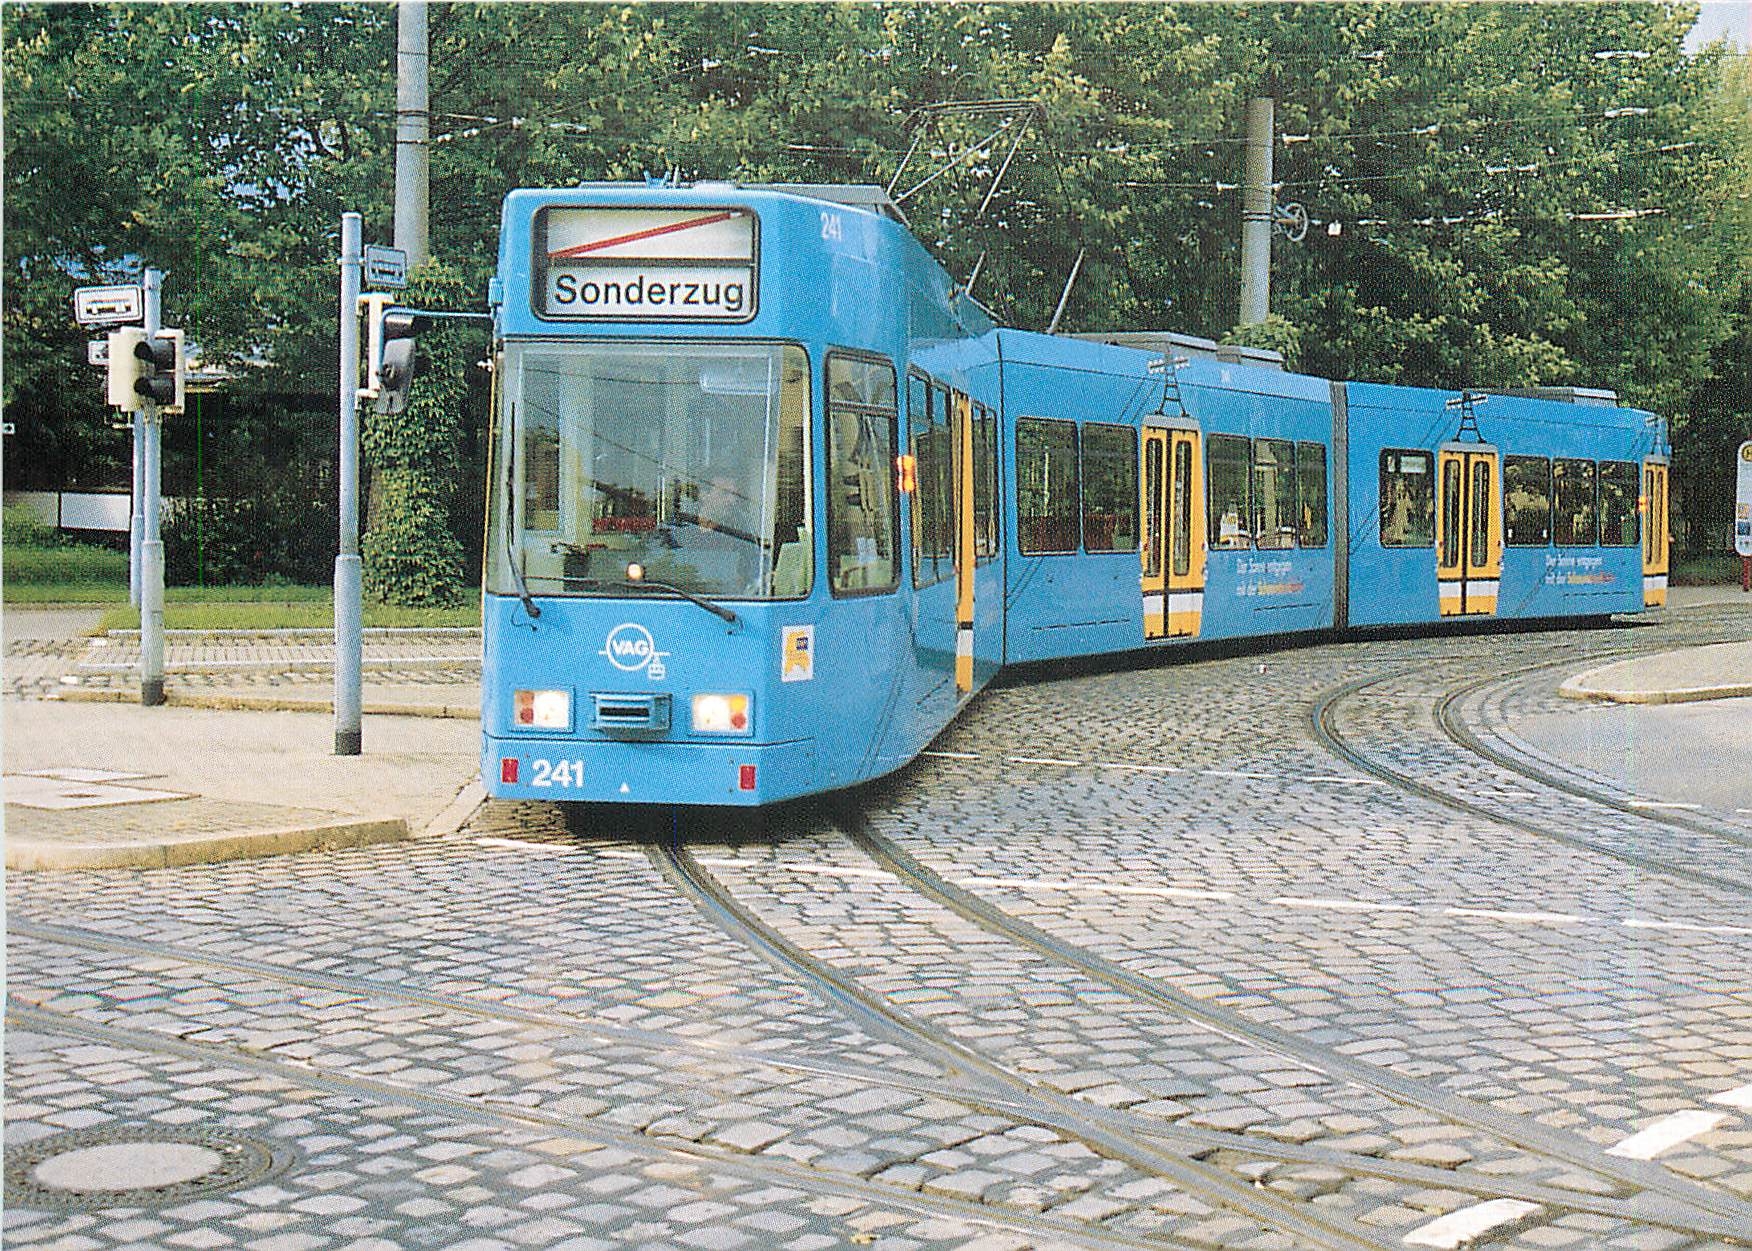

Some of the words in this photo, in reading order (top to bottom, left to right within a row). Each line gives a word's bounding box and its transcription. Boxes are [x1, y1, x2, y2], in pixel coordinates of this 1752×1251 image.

[820, 212, 843, 241] 241
[554, 274, 744, 311] Sonderzug
[611, 640, 649, 655] VAG
[531, 759, 584, 788] 241
